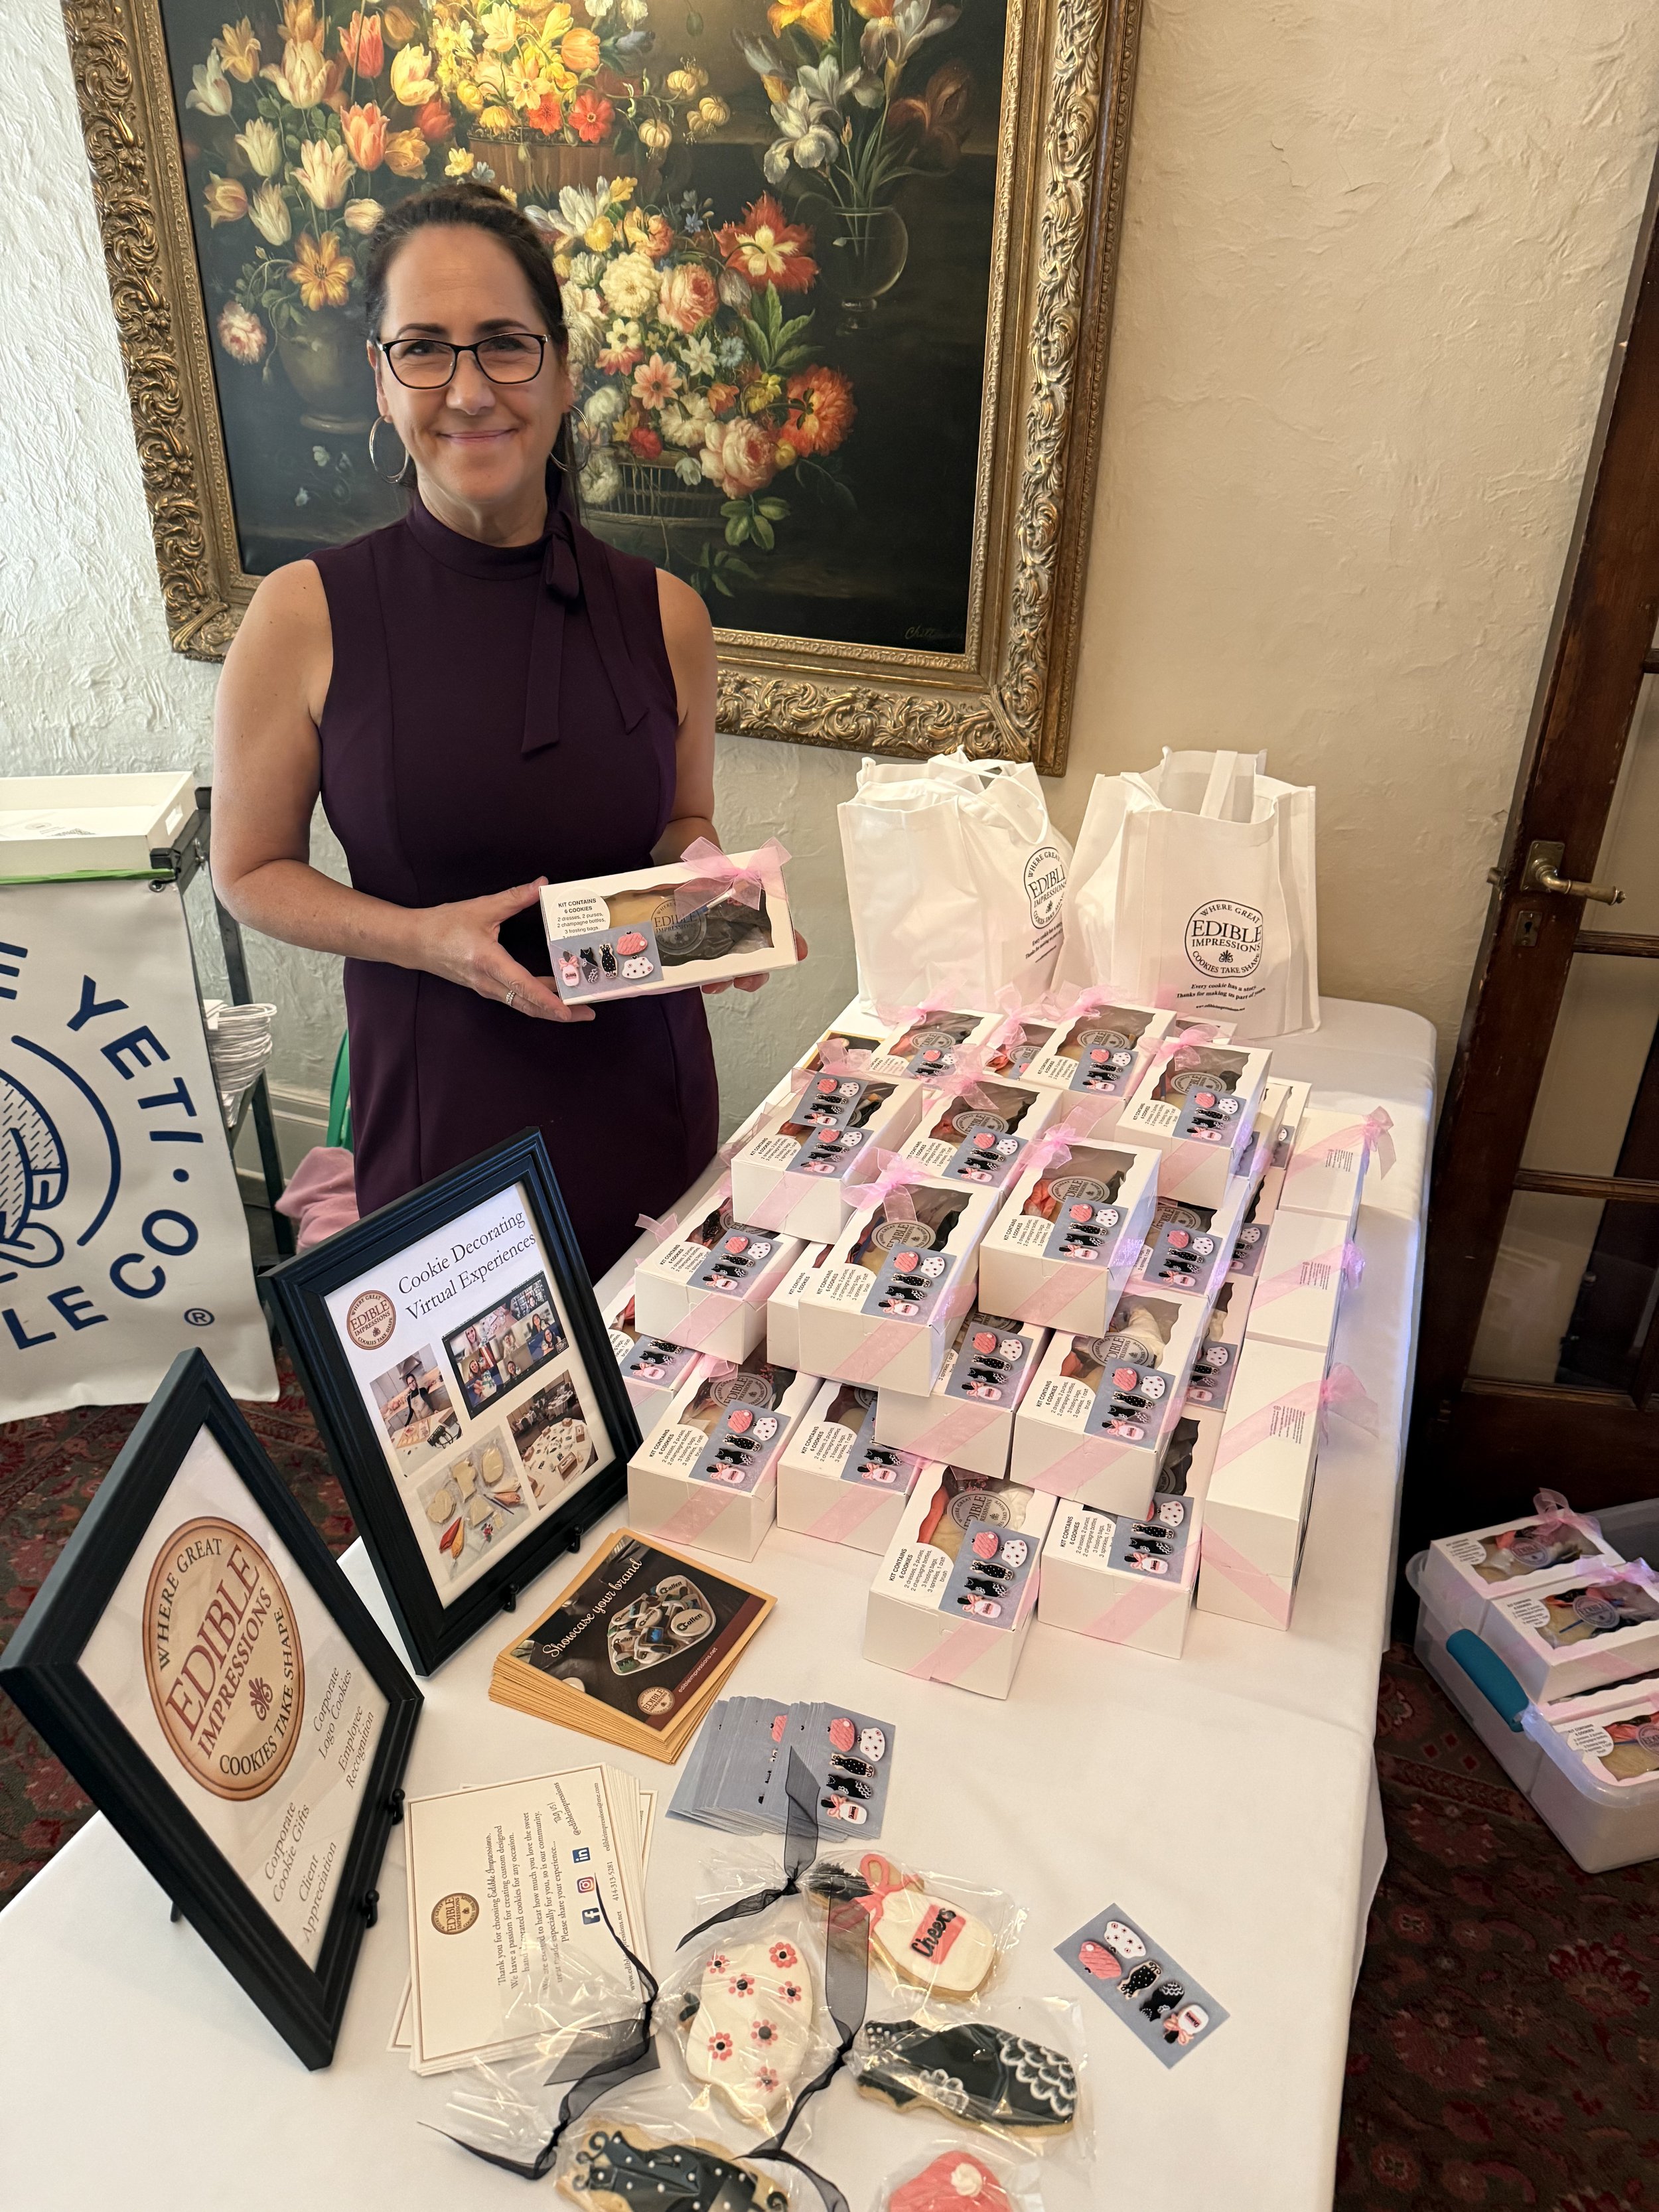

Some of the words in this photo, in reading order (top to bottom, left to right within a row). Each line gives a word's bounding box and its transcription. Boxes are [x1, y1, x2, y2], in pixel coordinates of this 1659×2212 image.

[1200, 904, 1232, 916] WHERE
[1235, 907, 1260, 923] GREAT
[1191, 920, 1262, 942] EDIBLE
[1192, 938, 1260, 952] IMPRESSIONS
[1192, 950, 1218, 972] COOKIES
[1241, 953, 1259, 972] SHAPE
[67, 974, 203, 1143] YETI
[399, 1257, 450, 1293] Cookie
[450, 1213, 525, 1263] Decorating
[406, 1280, 457, 1320] Virtual
[458, 1234, 536, 1290] Experiences
[350, 1300, 389, 1331] EDIBLE
[352, 1298, 366, 1315] WHERE
[354, 1311, 390, 1336] IMPRESSIONS
[1039, 1380, 1052, 1400] CONTAINS
[1046, 1386, 1058, 1402] COOKIES
[654, 1430, 670, 1449] CONTAINS
[660, 1434, 674, 1451] COOKIES
[804, 1426, 819, 1446] CONTAINS
[812, 1431, 824, 1448] COOKIES
[1062, 1516, 1074, 1539] CONTAINS
[1070, 1522, 1080, 1541] COOKIES
[893, 1548, 907, 1572] CONTAINS
[901, 1554, 913, 1575] COOKIES
[159, 1572, 179, 1670] WHERE
[178, 1537, 223, 1574] GREAT
[543, 1613, 595, 1657] Showcase
[593, 1589, 616, 1614] your
[609, 1558, 642, 1591] brand
[683, 1613, 703, 1627] Callen
[165, 1544, 261, 1740] EDIBLE
[273, 1607, 295, 1682] SHAPE
[198, 1587, 273, 1759] IMPRESSIONS
[678, 1647, 717, 1692] edibleimpressions.net
[272, 1685, 293, 1740] TAKE
[313, 1668, 338, 1731] Corporate
[642, 1688, 664, 1710] EDIBLE
[319, 1723, 335, 1759] Logo
[331, 1670, 351, 1720] Cookies
[338, 1706, 362, 1773] Employee
[346, 1712, 374, 1789] Recognition
[219, 1738, 279, 1776] COOKIES
[552, 1810, 563, 1823] Tag
[553, 1782, 581, 1836] @edibleimpressions
[594, 1783, 611, 1852] edibleimpressions@me.com
[265, 1802, 296, 1880] Corporate
[494, 1825, 506, 1853] designed
[534, 1811, 544, 1849] community.
[273, 1846, 296, 1902] Cookie
[292, 1805, 309, 1842] Gifts
[484, 1833, 496, 1874] Impressions.
[508, 1832, 517, 1862] occasion.
[530, 1857, 538, 1870] you
[551, 1841, 562, 1881] experience...
[299, 1855, 319, 1902] Client
[487, 1875, 497, 1898] Edible
[528, 1871, 538, 1891] much
[544, 1880, 553, 1895] you,
[556, 1883, 565, 1899] your
[607, 1862, 619, 1901] 414-313-5281
[303, 1842, 336, 1943] Appreciation
[502, 1880, 510, 1907] creating
[514, 1888, 523, 1914] cookies
[444, 1897, 457, 1931] EDIBLE
[491, 1898, 501, 1930] choosing
[503, 1910, 512, 1920] for
[557, 1901, 566, 1919] share
[506, 1922, 517, 1949] passion
[545, 1909, 559, 1942] especially
[561, 1921, 569, 1943] Please
[912, 1908, 956, 1956] Cheers
[497, 1944, 506, 1958] you
[520, 1953, 530, 1972] hand
[617, 1911, 636, 1990] www.ediblepressions.net
[496, 1960, 506, 1985] Thank
[509, 1956, 518, 1974] have
[510, 1975, 518, 1989] We
